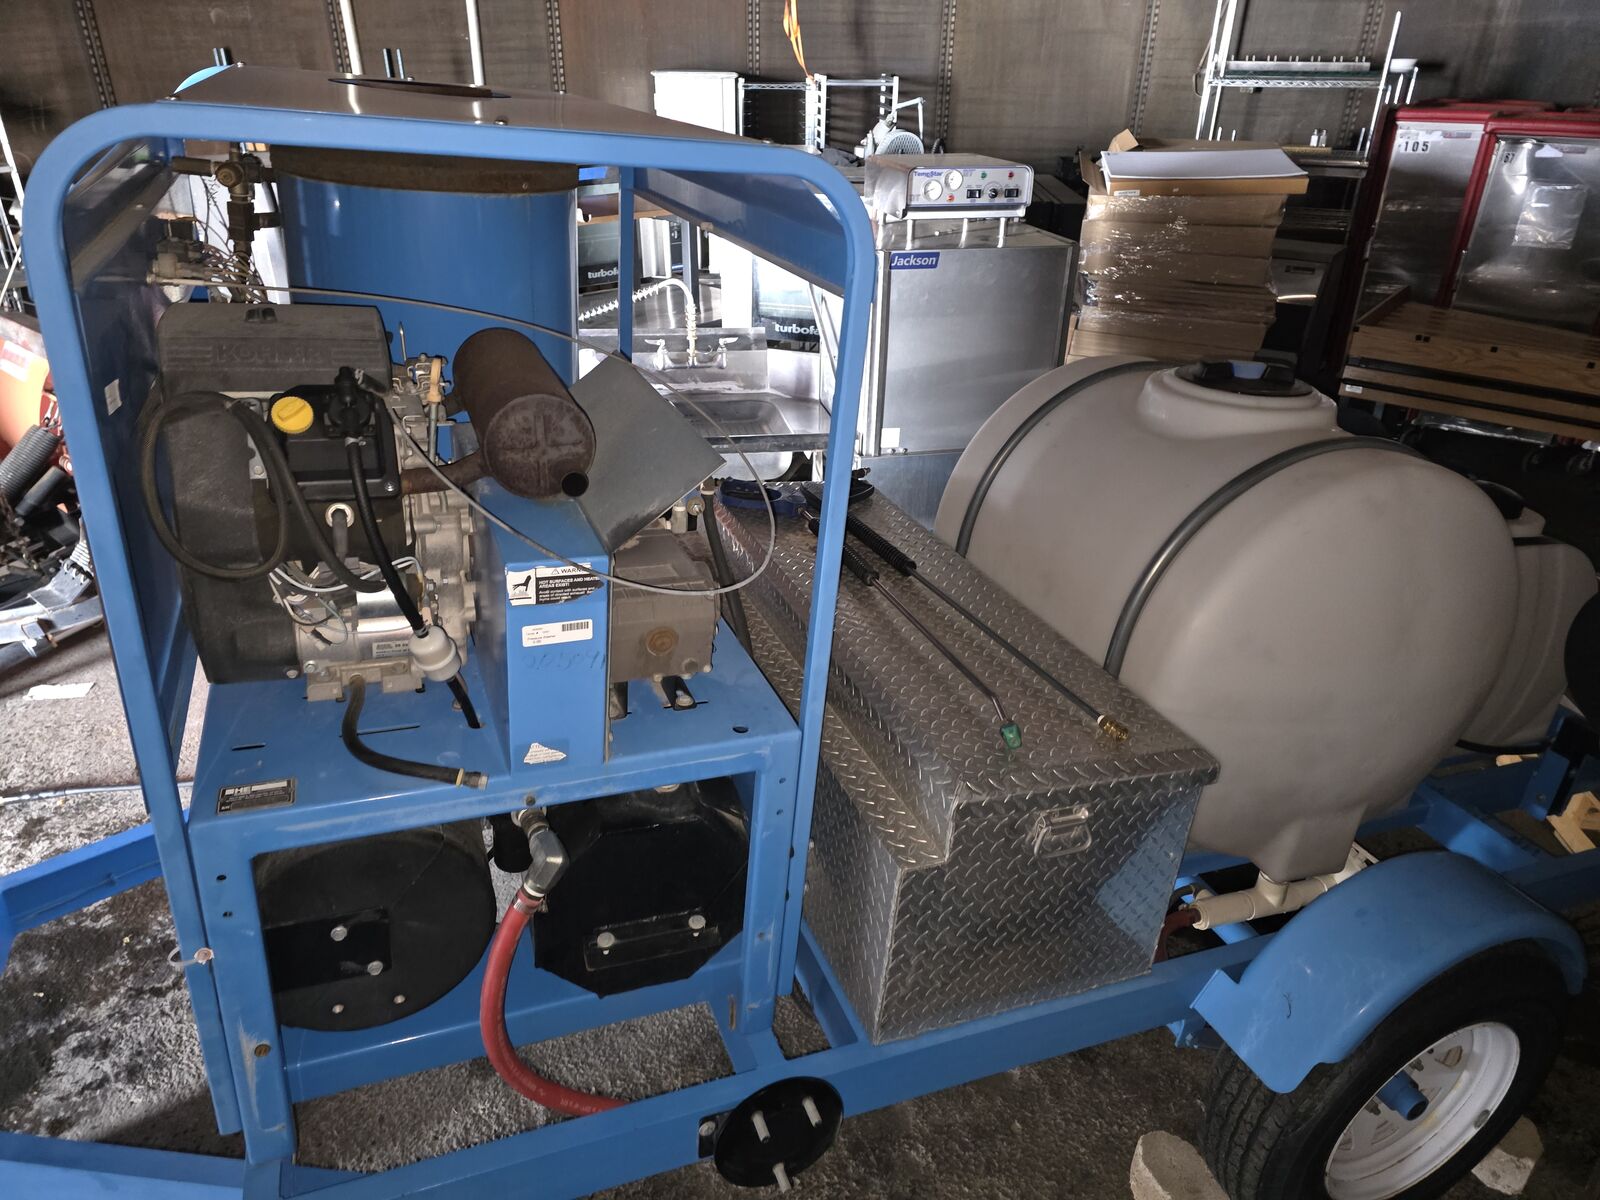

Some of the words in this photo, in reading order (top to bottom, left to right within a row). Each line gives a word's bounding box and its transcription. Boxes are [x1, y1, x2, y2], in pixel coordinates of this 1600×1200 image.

[1404, 141, 1430, 152] 105
[891, 254, 936, 266] Jackson
[587, 267, 618, 279] turbof
[774, 323, 820, 336] turbofa
